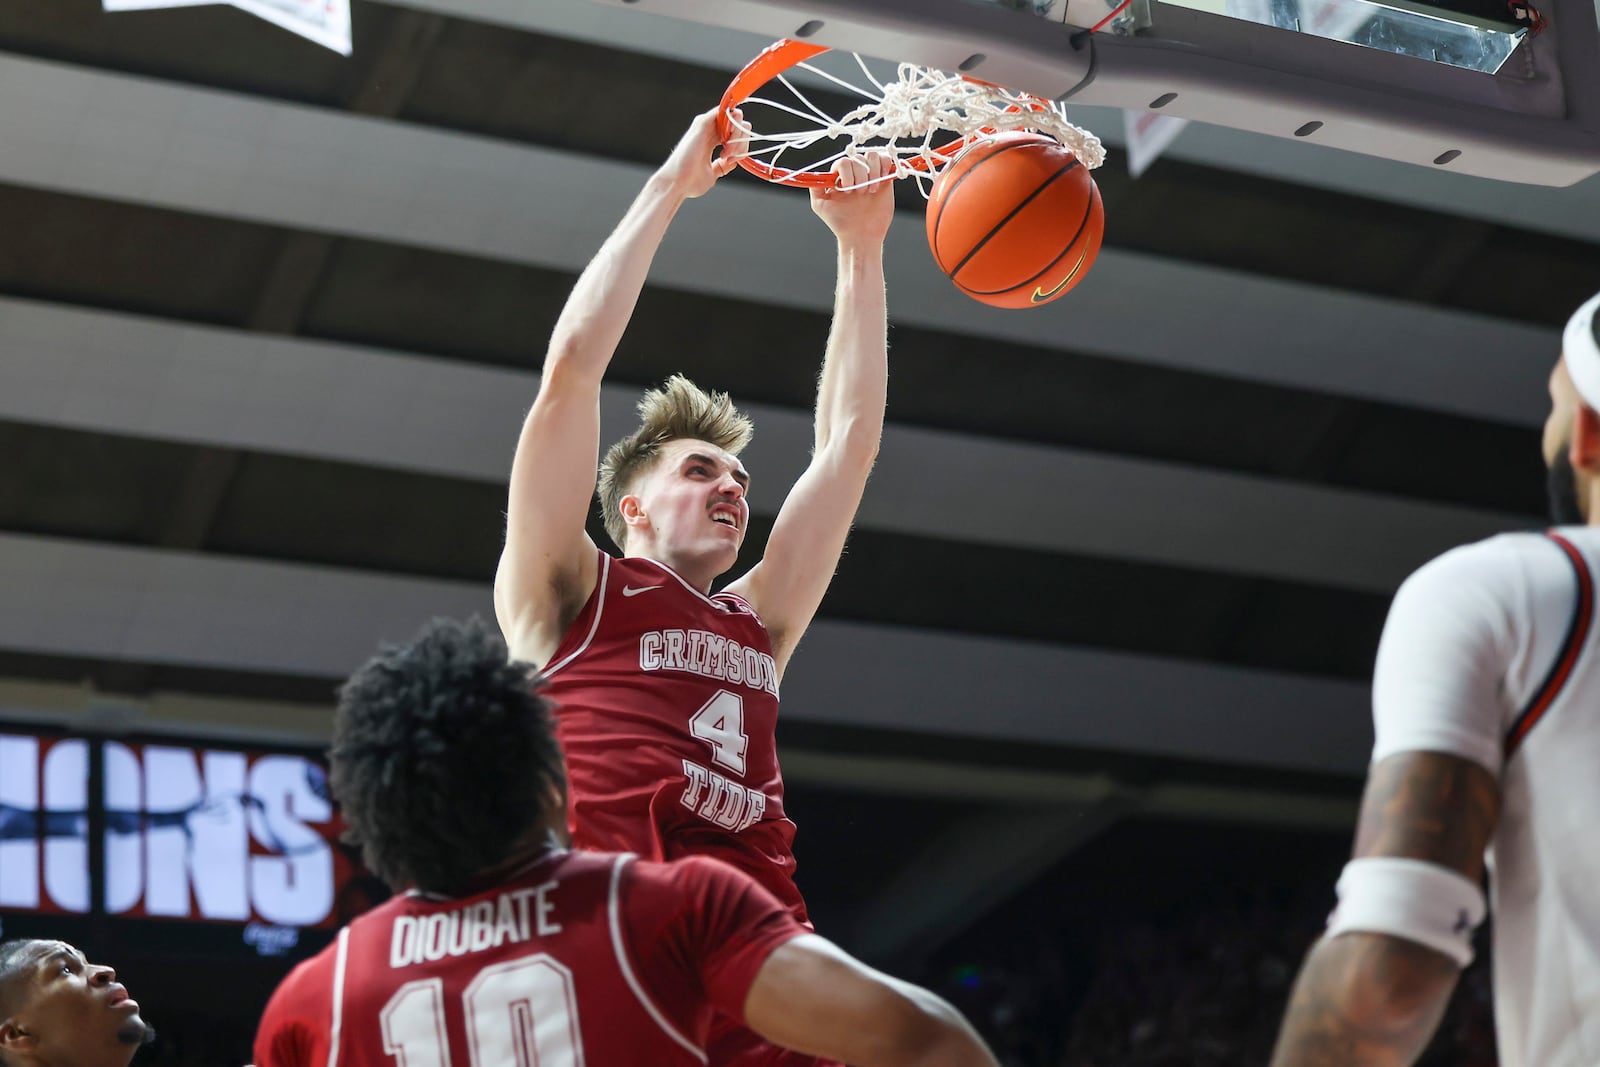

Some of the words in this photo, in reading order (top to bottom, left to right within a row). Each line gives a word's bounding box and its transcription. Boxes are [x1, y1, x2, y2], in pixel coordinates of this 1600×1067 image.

[639, 628, 781, 703] CRIMSON
[688, 688, 749, 778] 4
[390, 880, 562, 968] DIOUBATE
[379, 952, 586, 1067] 10
